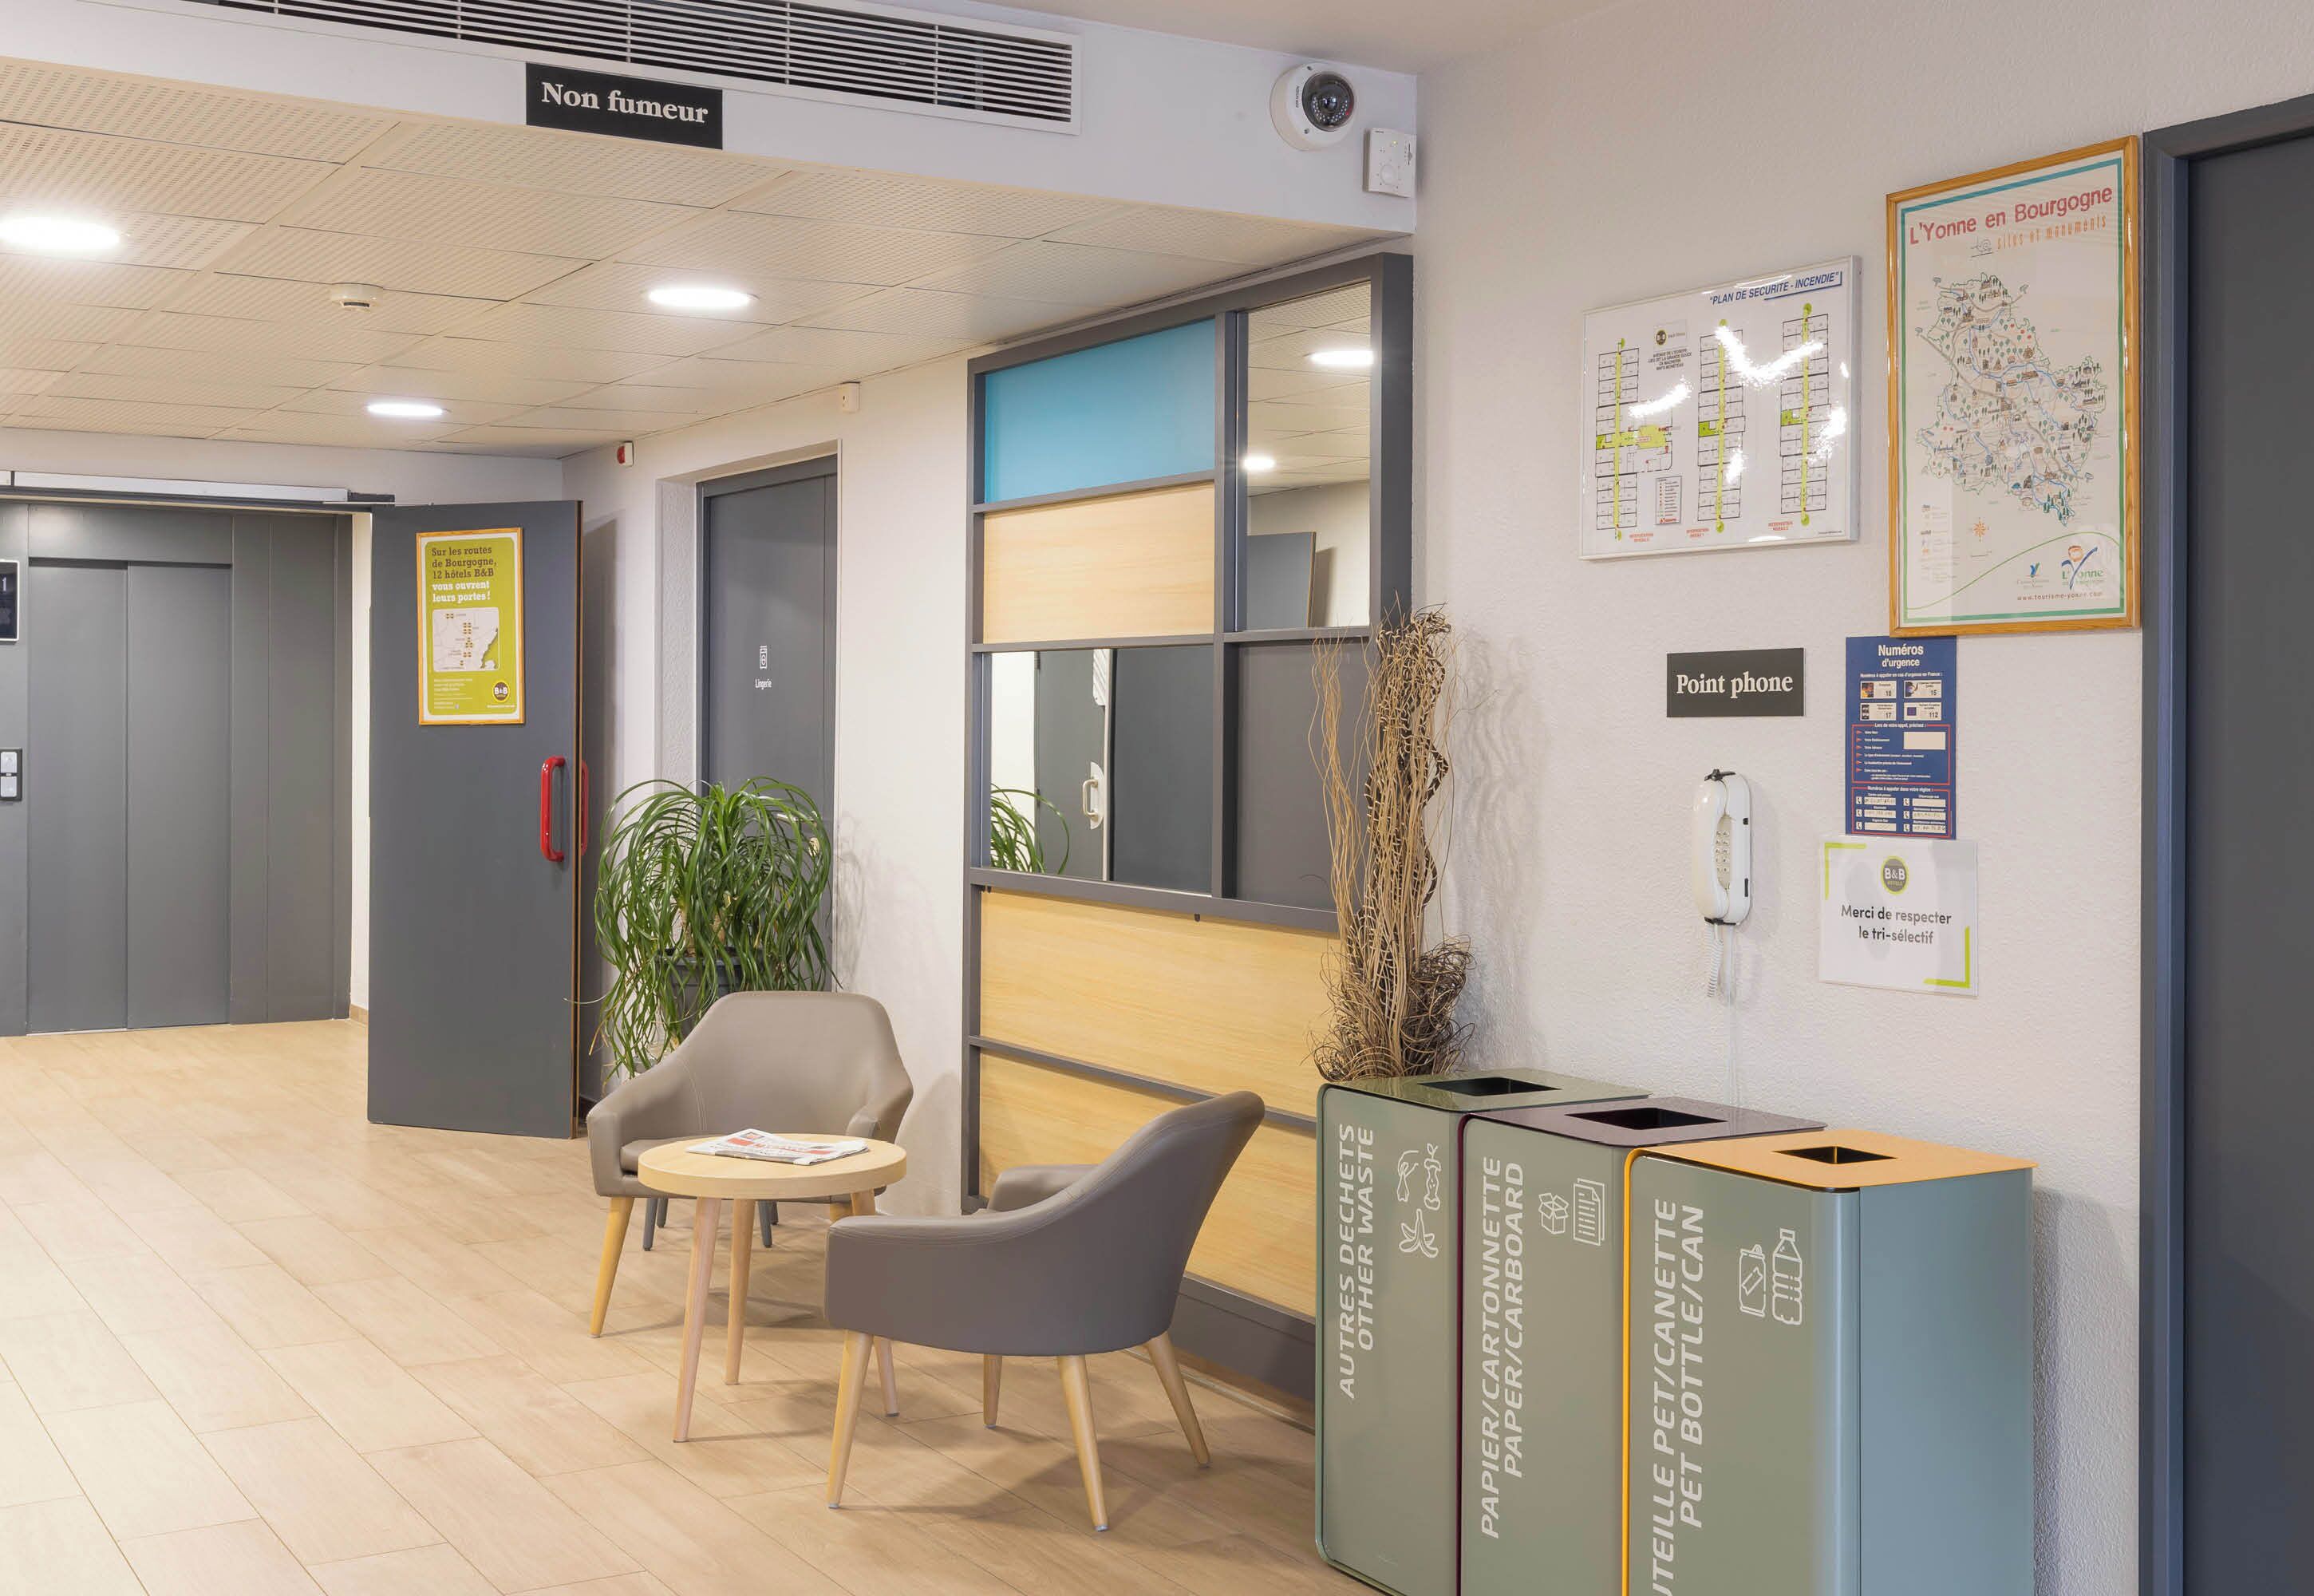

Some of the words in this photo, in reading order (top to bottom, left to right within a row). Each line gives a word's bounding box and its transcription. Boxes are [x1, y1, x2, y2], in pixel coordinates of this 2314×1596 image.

[541, 81, 599, 109] Non
[607, 90, 709, 123] fumeur
[1909, 217, 1977, 244] L'Yonne
[1985, 211, 2006, 228] en
[2014, 187, 2113, 223] Bourgogne
[1736, 290, 1746, 300] DE
[1748, 282, 1789, 298] SECURITE
[432, 547, 447, 556] Sur
[449, 547, 461, 556] les
[464, 547, 492, 555] routes
[445, 558, 497, 569] Bourgogne,
[433, 571, 442, 579] 12
[445, 569, 472, 579] hôtels
[474, 567, 494, 577] B&B
[456, 581, 490, 590] ouvrent
[432, 593, 456, 602] leurs
[1878, 643, 1924, 657] Numéros
[1882, 658, 1921, 669] d'urgence
[1676, 674, 1725, 694] Point
[1730, 671, 1793, 698] phone
[1885, 867, 1905, 880] B&B
[1841, 904, 1874, 918] Merci
[1878, 907, 1892, 920] de
[1895, 911, 1952, 926] respecter
[1858, 926, 1869, 939] le
[1872, 927, 1933, 944] tri-sélectif
[1357, 1127, 1373, 1234] WASTE
[1339, 1124, 1355, 1266] DECHETS
[1357, 1244, 1373, 1350] OTHER
[1505, 1162, 1524, 1478] PAPER/CARBOARD
[1653, 1199, 1676, 1456] PET/CANETTE
[1681, 1205, 1704, 1445] BOTTLE/CAN
[1339, 1274, 1355, 1399] AUTRES
[1481, 1156, 1501, 1539] PAPIER/CARTONNETTE
[1680, 1452, 1703, 1528] PET
